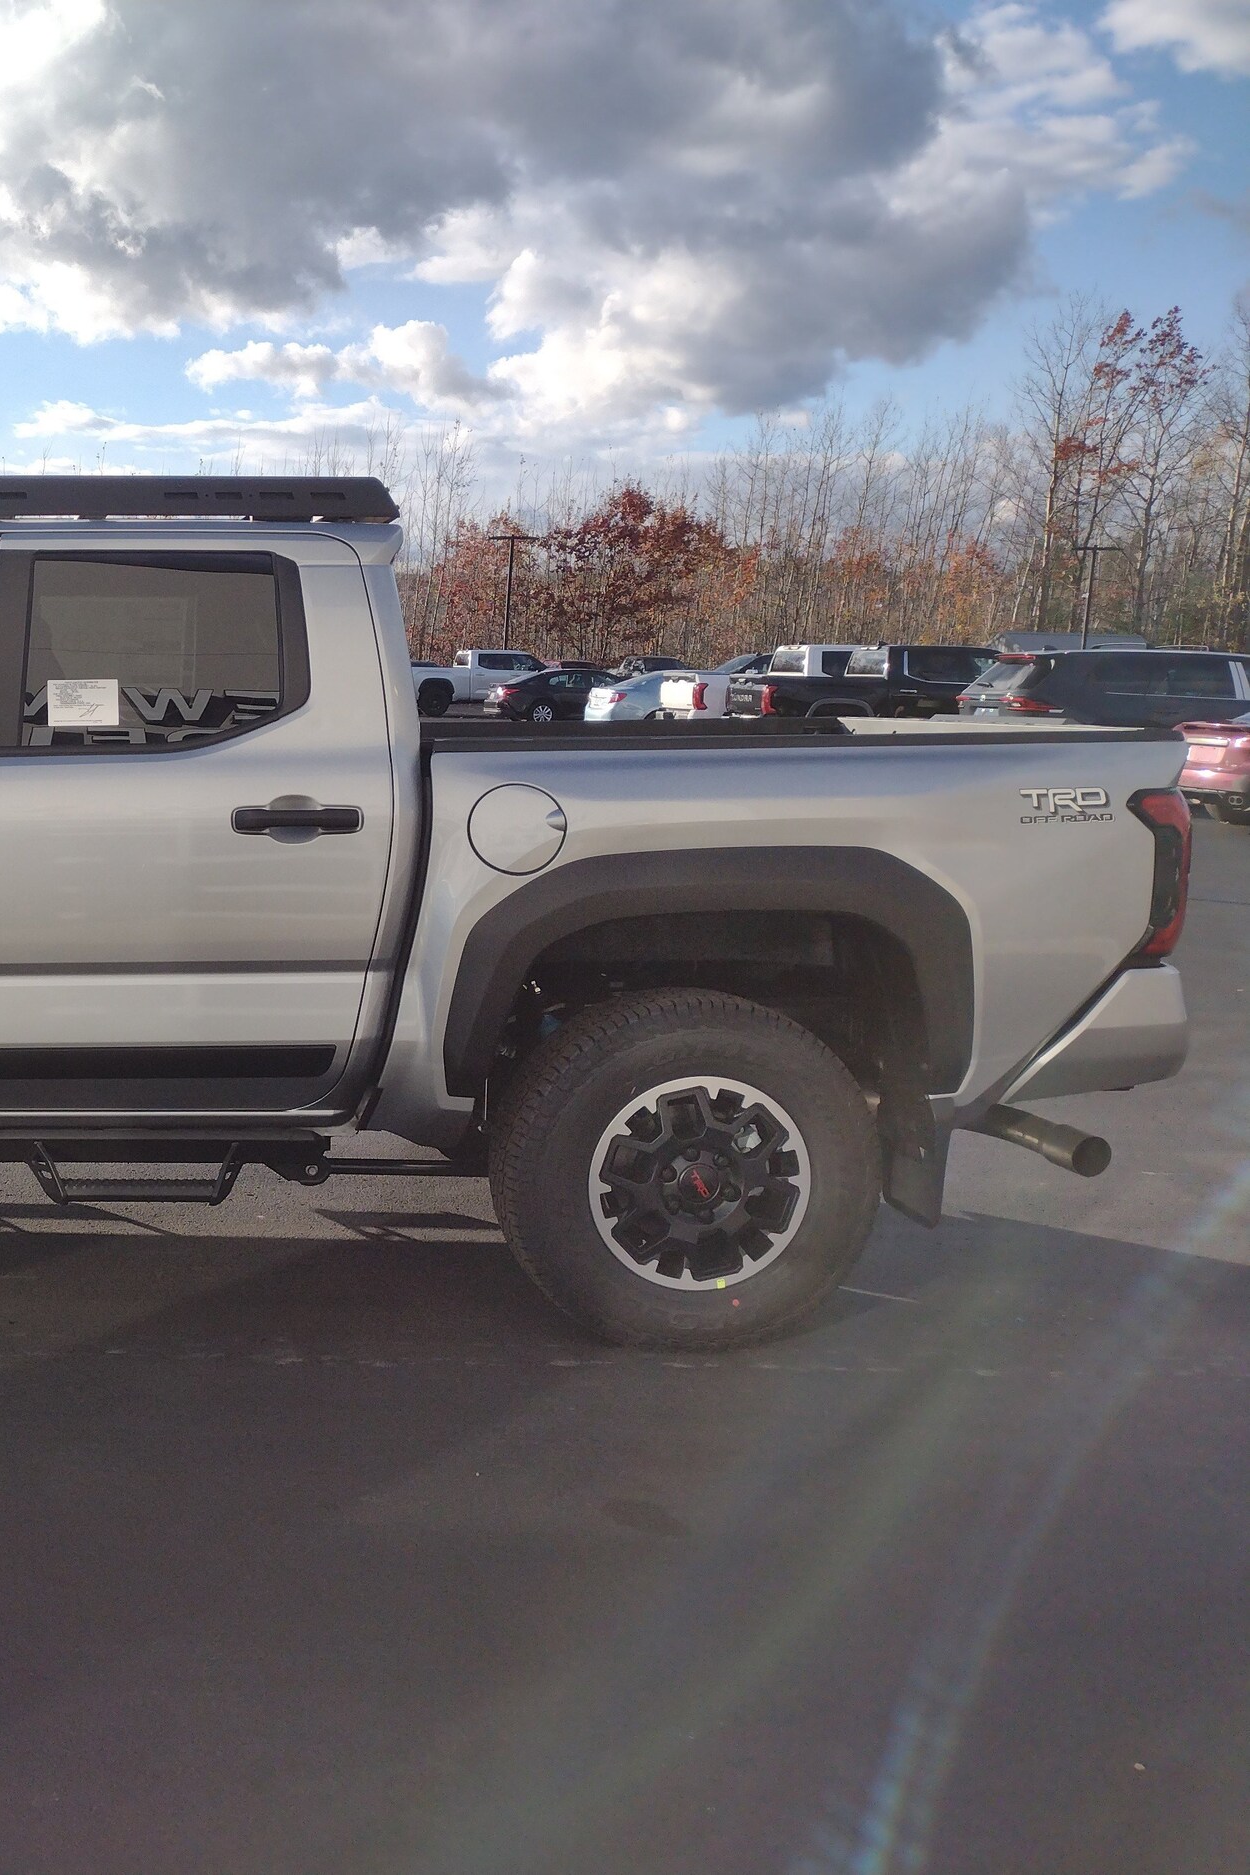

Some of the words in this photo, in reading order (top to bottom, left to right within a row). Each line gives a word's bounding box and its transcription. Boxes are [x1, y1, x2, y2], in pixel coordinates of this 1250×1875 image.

[1019, 788, 1108, 812] TRD
[1020, 816, 1057, 825] OFF
[1061, 814, 1114, 823] ROAD
